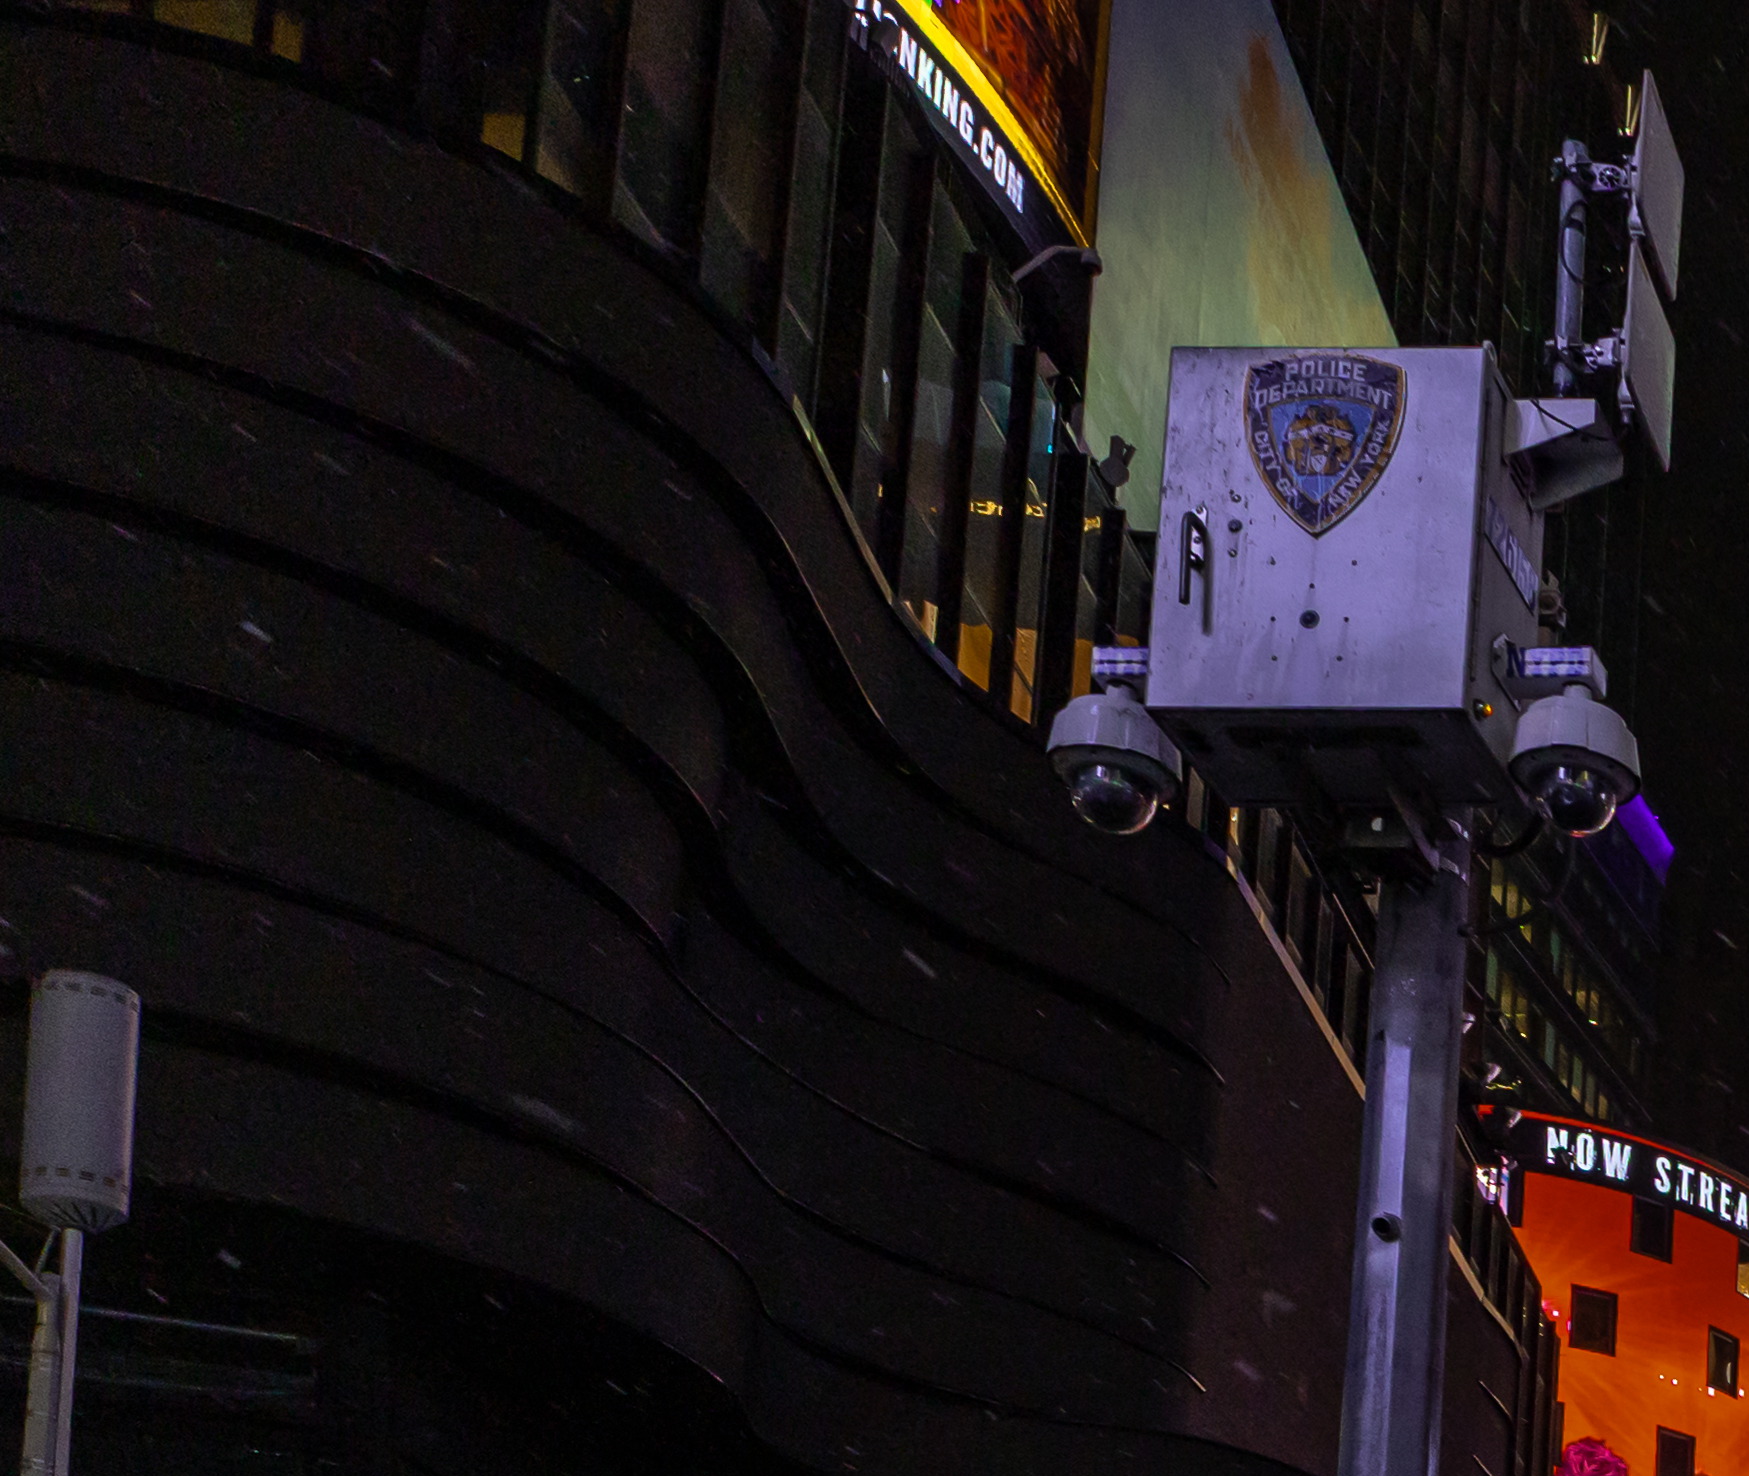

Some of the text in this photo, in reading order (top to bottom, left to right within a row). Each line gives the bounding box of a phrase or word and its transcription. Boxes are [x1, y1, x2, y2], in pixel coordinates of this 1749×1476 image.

[1285, 359, 1367, 381] POLICE
[1253, 378, 1393, 410] DEPARTMENT
[1547, 1126, 1632, 1181] NOW
